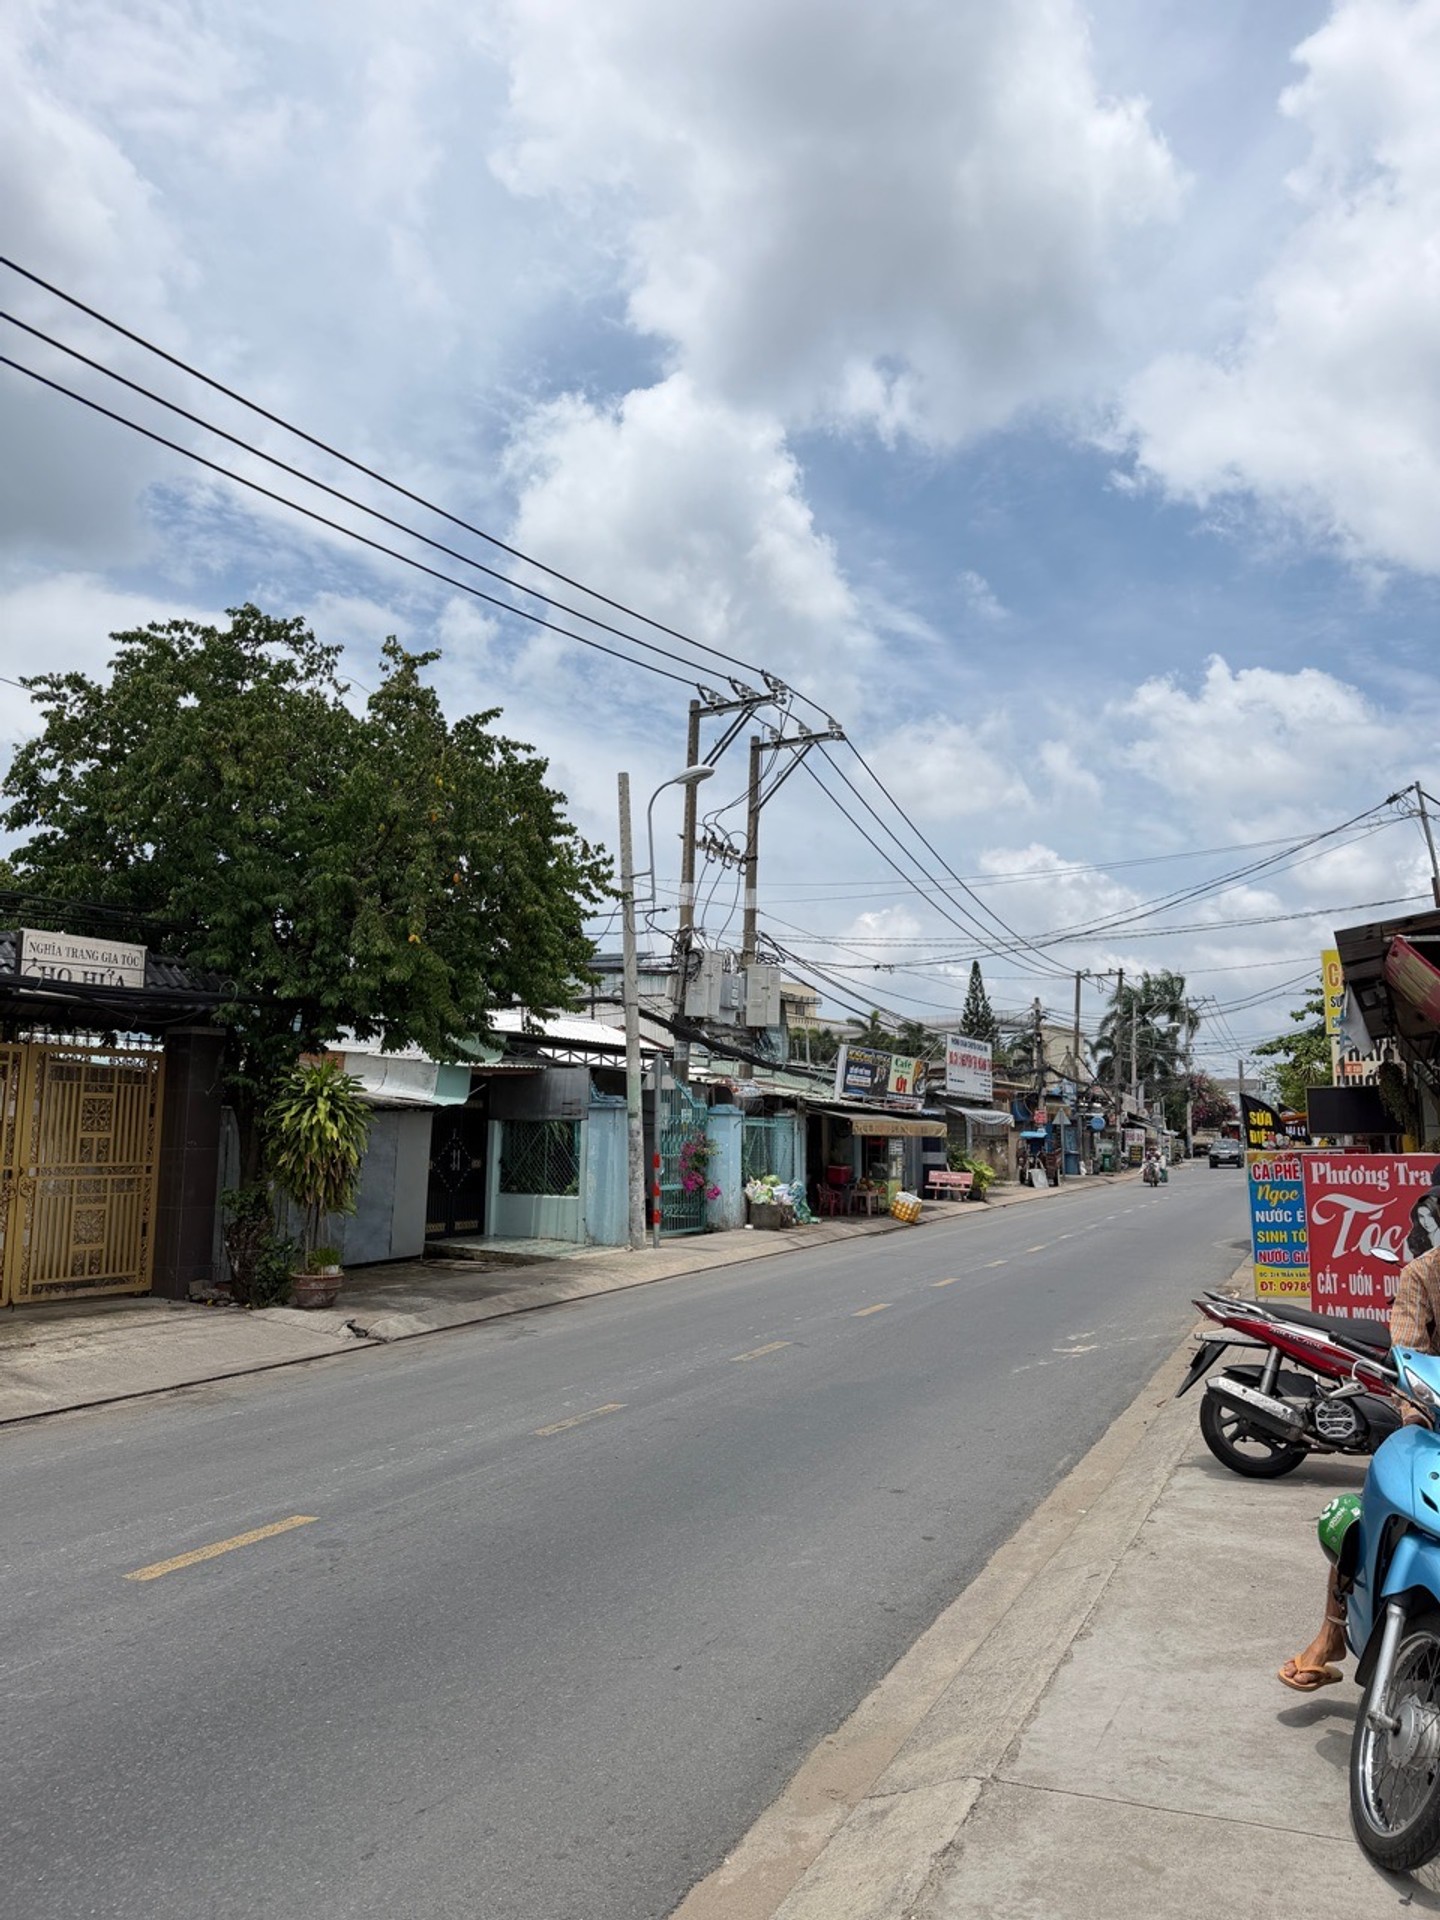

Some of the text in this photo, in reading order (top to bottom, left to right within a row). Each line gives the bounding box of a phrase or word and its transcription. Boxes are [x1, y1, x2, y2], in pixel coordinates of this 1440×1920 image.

[65, 946, 99, 961] TRANG
[101, 951, 118, 963] GIA
[1274, 1158, 1301, 1181] PHÊ
[1311, 1161, 1434, 1192] Phương Tra
[1257, 1184, 1299, 1207] Ngọc
[1255, 1208, 1293, 1223] NƯỚC
[1311, 1193, 1405, 1259] Tóc
[1257, 1230, 1287, 1243] SINH
[1257, 1248, 1290, 1264] NƯỚC
[1317, 1264, 1338, 1294] CẮT
[1348, 1266, 1373, 1296] UỐN
[1383, 1274, 1400, 1297] DU
